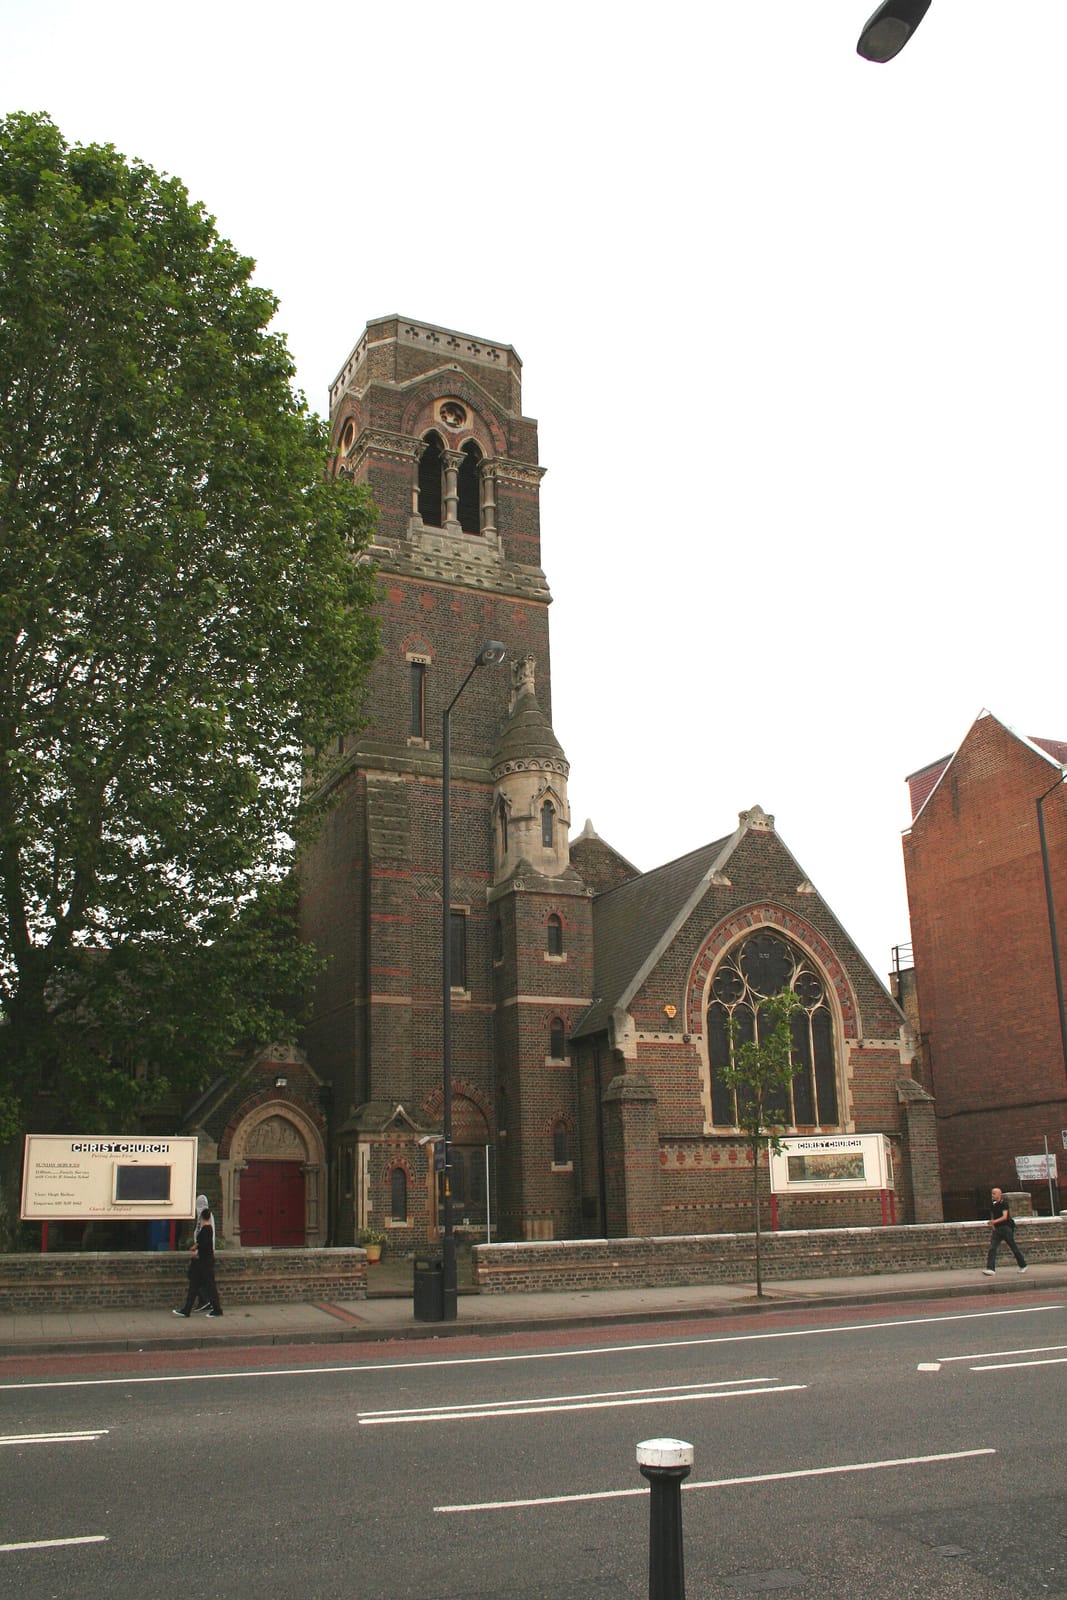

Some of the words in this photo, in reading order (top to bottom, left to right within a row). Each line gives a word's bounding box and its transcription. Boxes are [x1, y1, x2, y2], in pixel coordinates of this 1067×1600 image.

[72, 1143, 117, 1152] CHRIST
[119, 1144, 169, 1153] CHURCH
[798, 1141, 826, 1149] CHRIST
